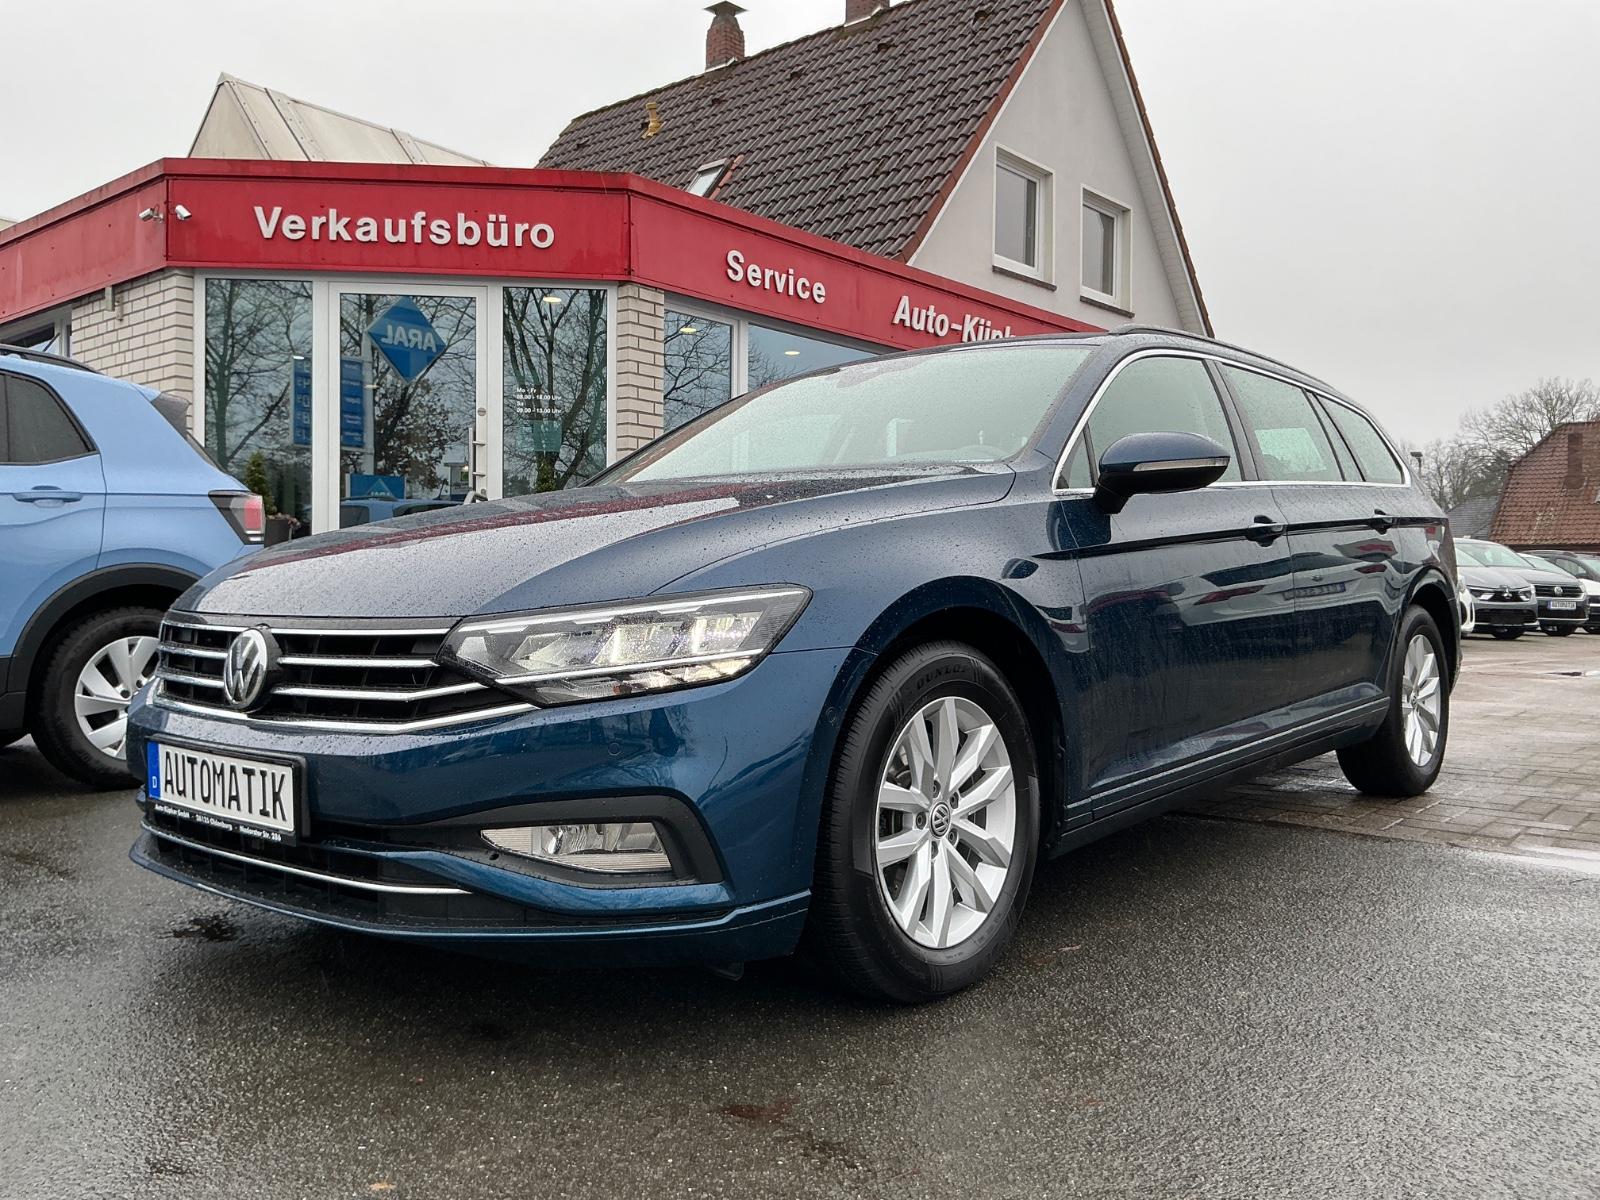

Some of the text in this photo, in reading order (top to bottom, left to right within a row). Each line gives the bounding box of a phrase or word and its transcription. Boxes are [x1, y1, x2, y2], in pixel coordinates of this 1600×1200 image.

[253, 205, 556, 249] Verkaufsbüro
[726, 250, 826, 304] Service
[892, 294, 1016, 343] Auto-Kü
[152, 776, 157, 788] D
[164, 751, 287, 822] AUTOMATIK
